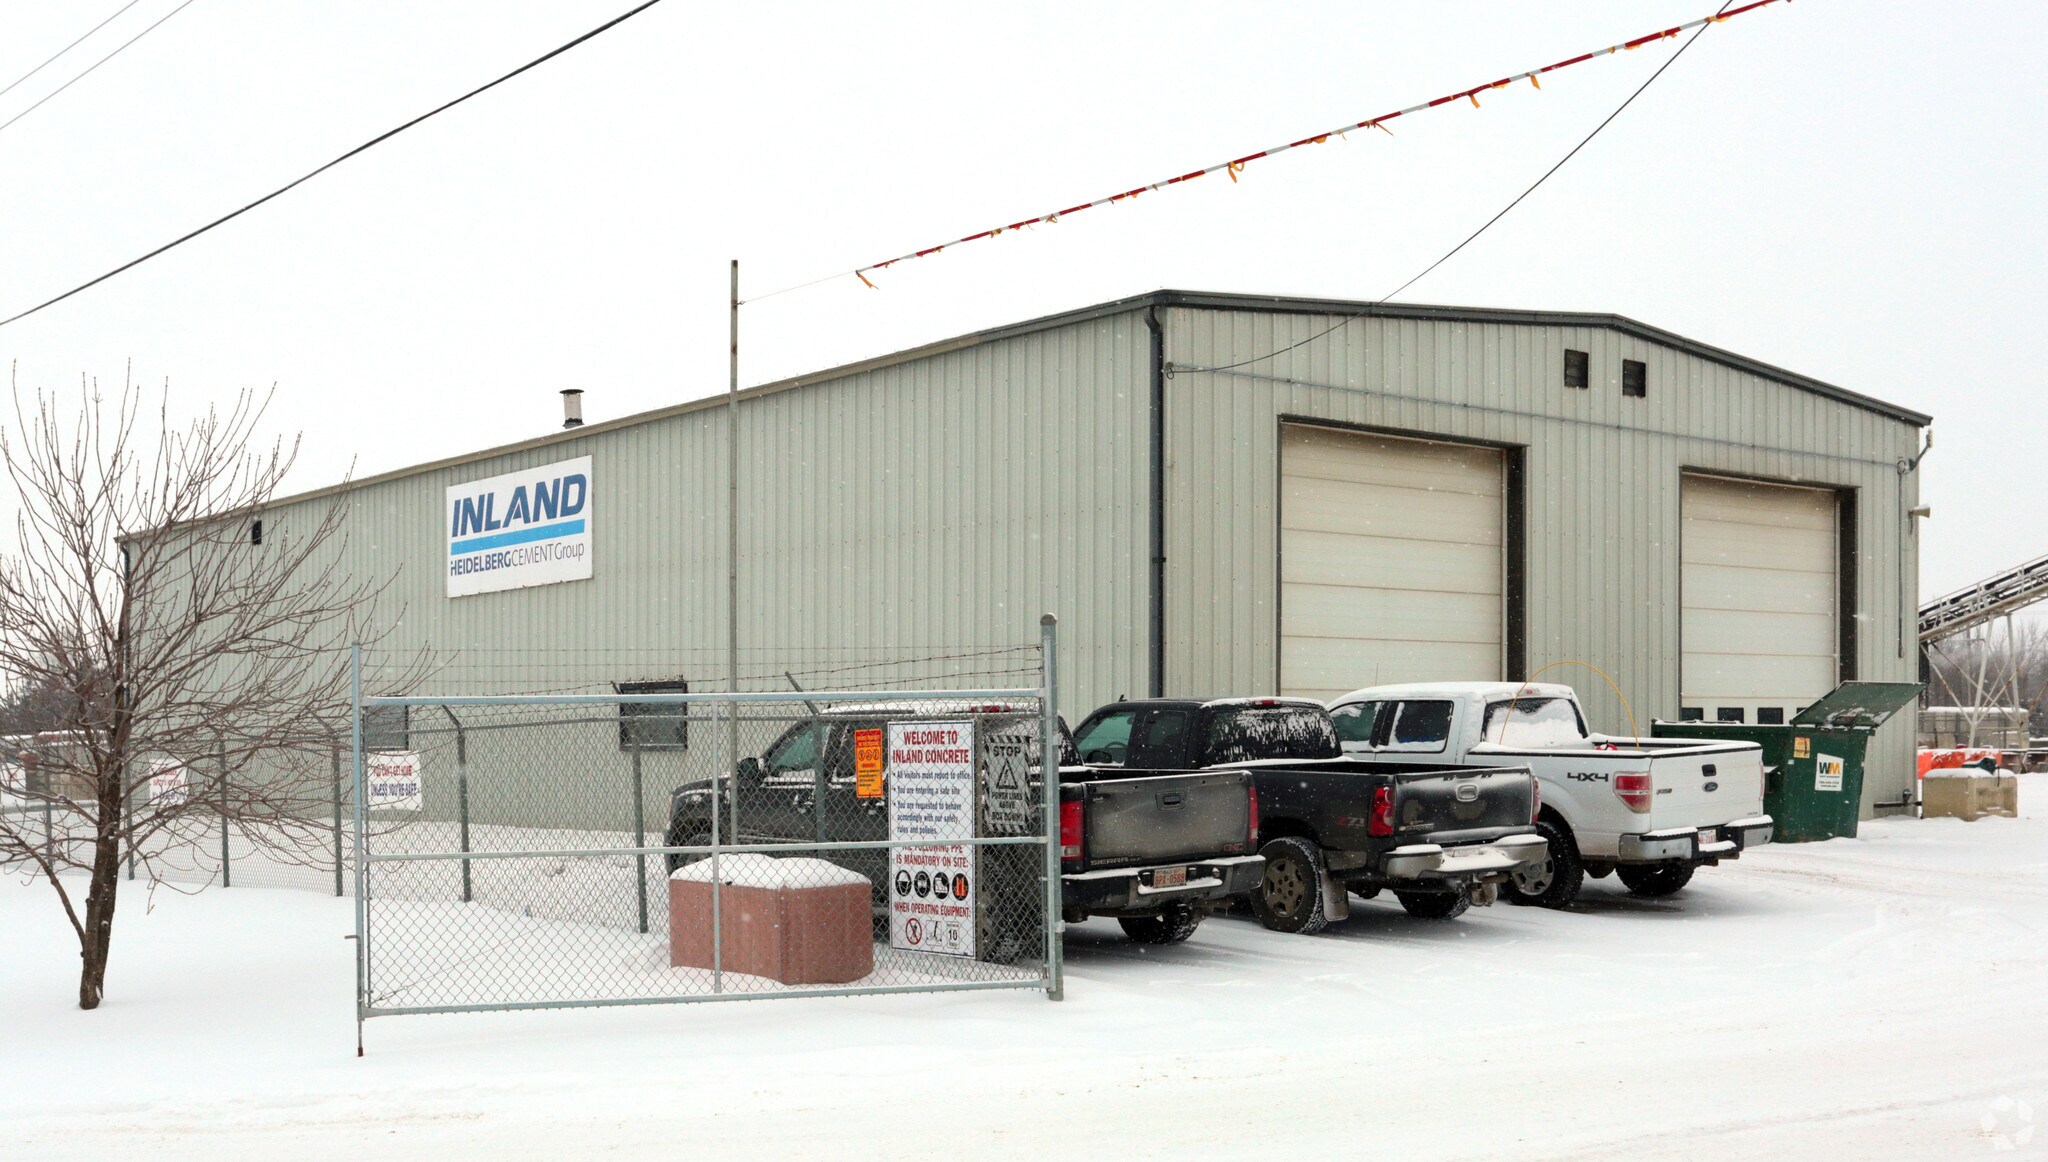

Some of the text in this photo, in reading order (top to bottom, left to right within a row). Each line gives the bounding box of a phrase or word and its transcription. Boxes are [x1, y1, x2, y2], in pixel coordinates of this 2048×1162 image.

[452, 473, 587, 538] INLAND
[450, 542, 585, 577] HEIDELBERGCEMENT Group
[903, 730, 958, 746] WELCOME TO
[892, 749, 970, 764] INLAND CONCRETE
[993, 745, 1021, 757] STOP
[1819, 762, 1840, 774] WM
[904, 770, 921, 779] visitors
[922, 771, 934, 779] must
[934, 771, 949, 781] report
[950, 771, 956, 780] to
[897, 786, 905, 794] You
[915, 786, 934, 796] entering
[951, 786, 960, 795] site
[897, 801, 905, 809] You
[915, 802, 938, 811] requested
[945, 802, 962, 811] behave
[897, 814, 922, 823] accordingly
[924, 814, 934, 822] with
[897, 825, 908, 833] rules
[909, 826, 918, 834] and
[896, 854, 902, 864] IS
[904, 854, 941, 867] MANDATORY
[941, 856, 952, 867] ON
[1090, 856, 1130, 866] SIERRA
[894, 902, 909, 912] WHEN
[911, 903, 939, 915] OPERATING
[948, 929, 958, 941] 10
